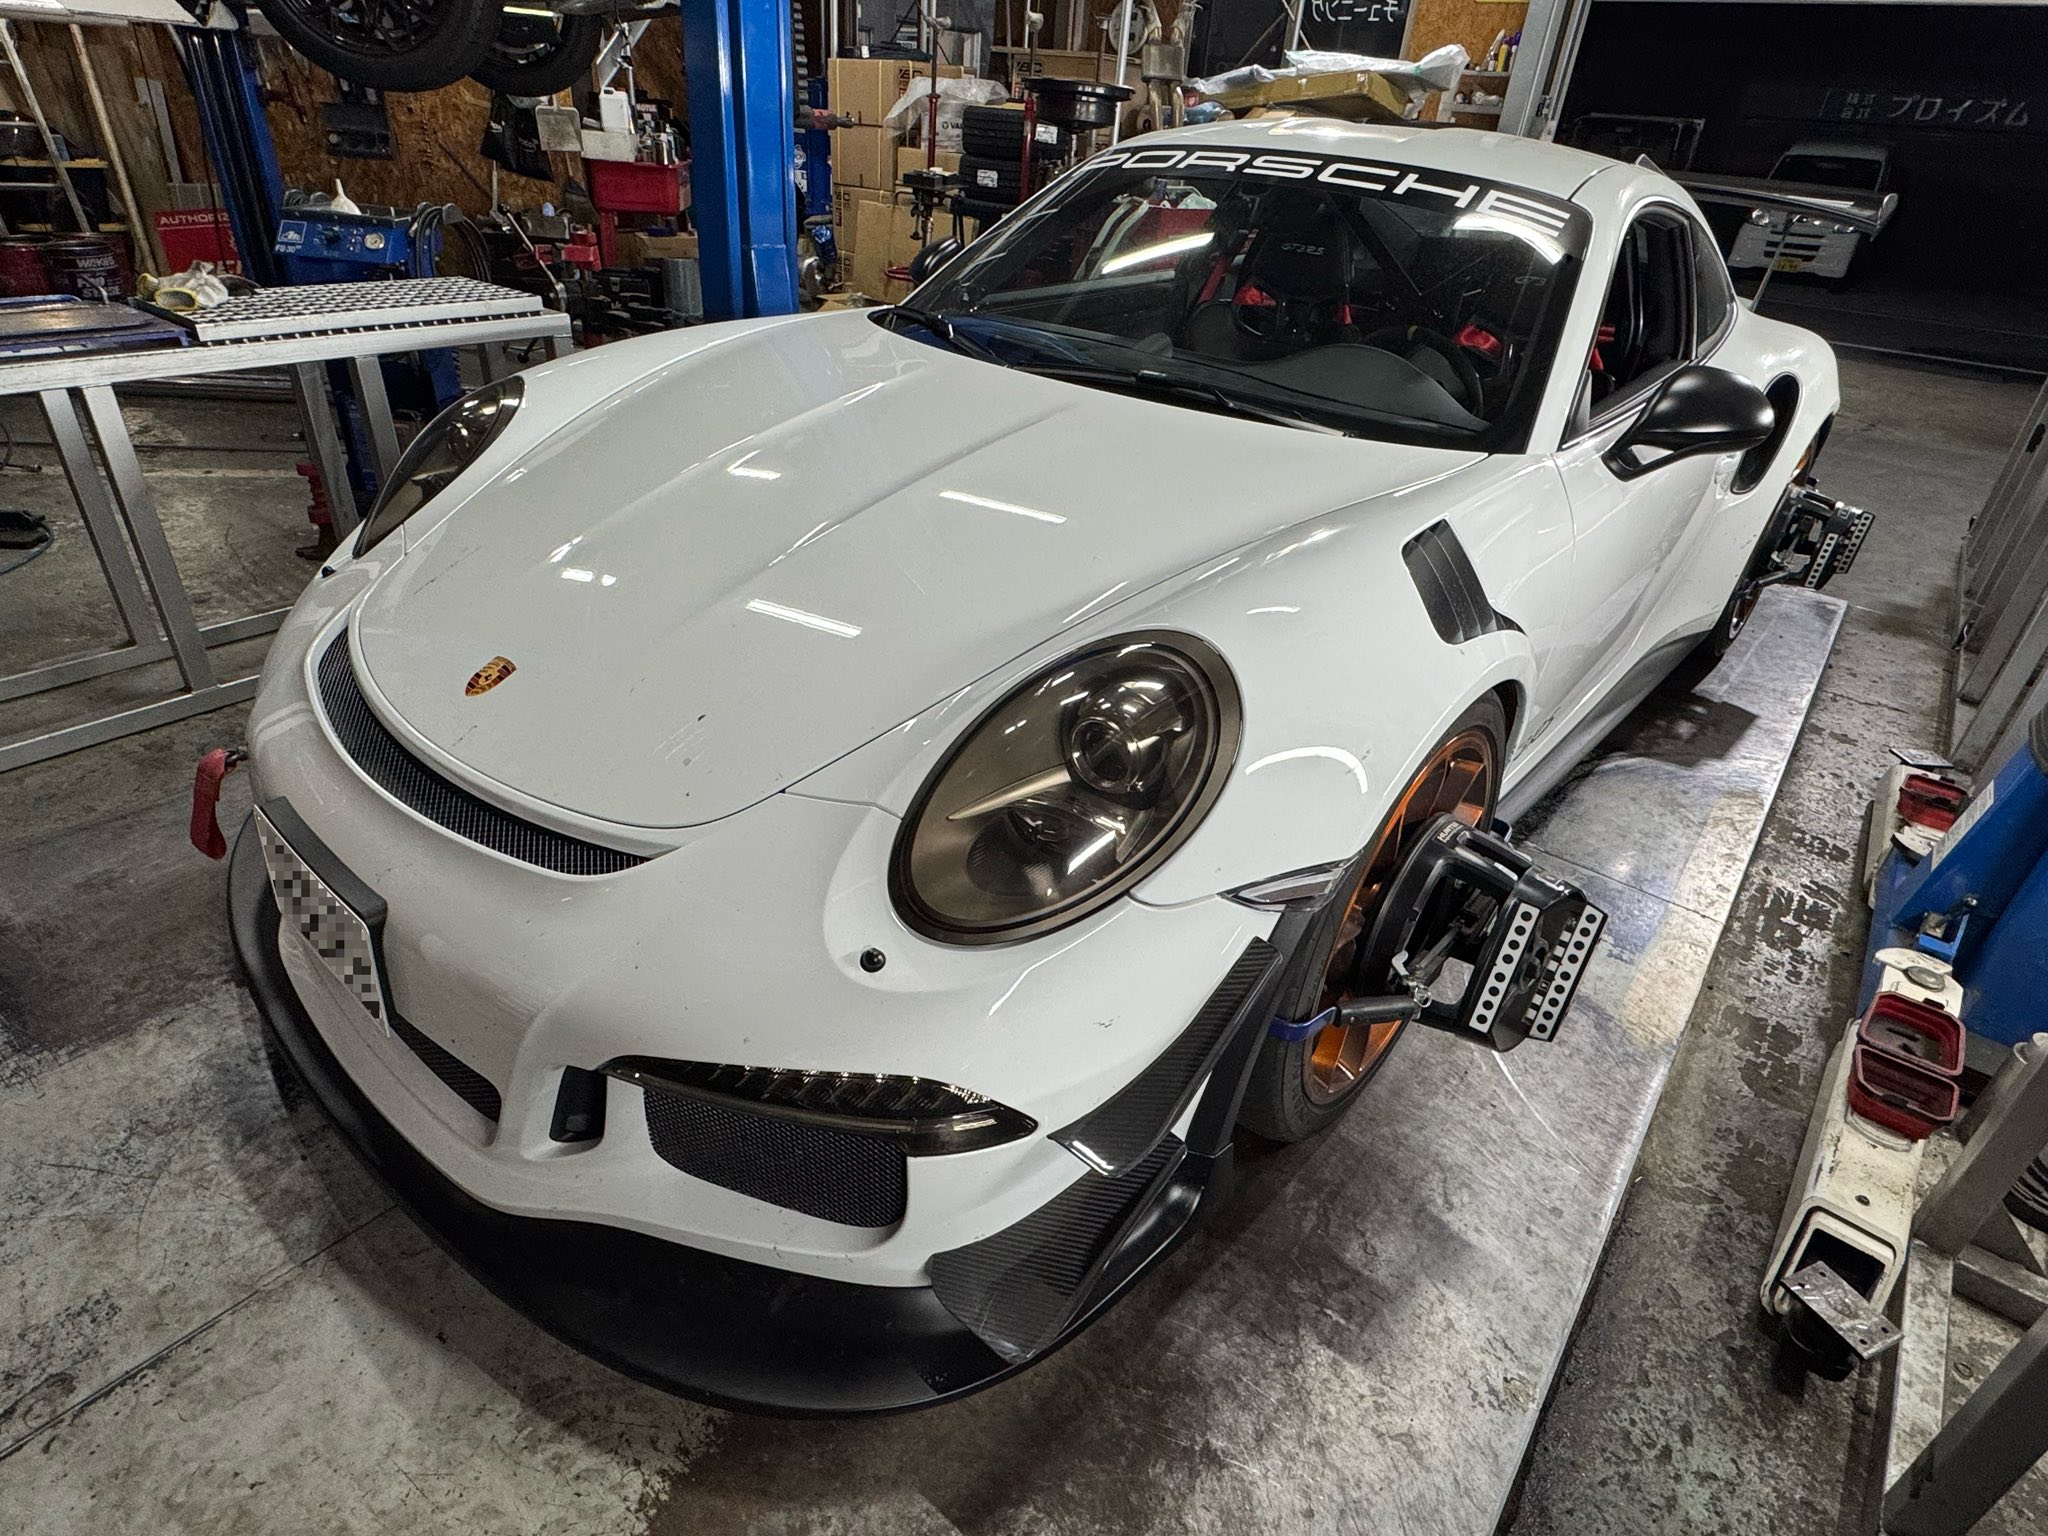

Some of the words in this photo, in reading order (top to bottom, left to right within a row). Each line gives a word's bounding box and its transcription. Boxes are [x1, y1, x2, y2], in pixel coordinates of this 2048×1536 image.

[1889, 94, 2029, 126] プロイズム
[1073, 150, 1571, 238] PORSCHE
